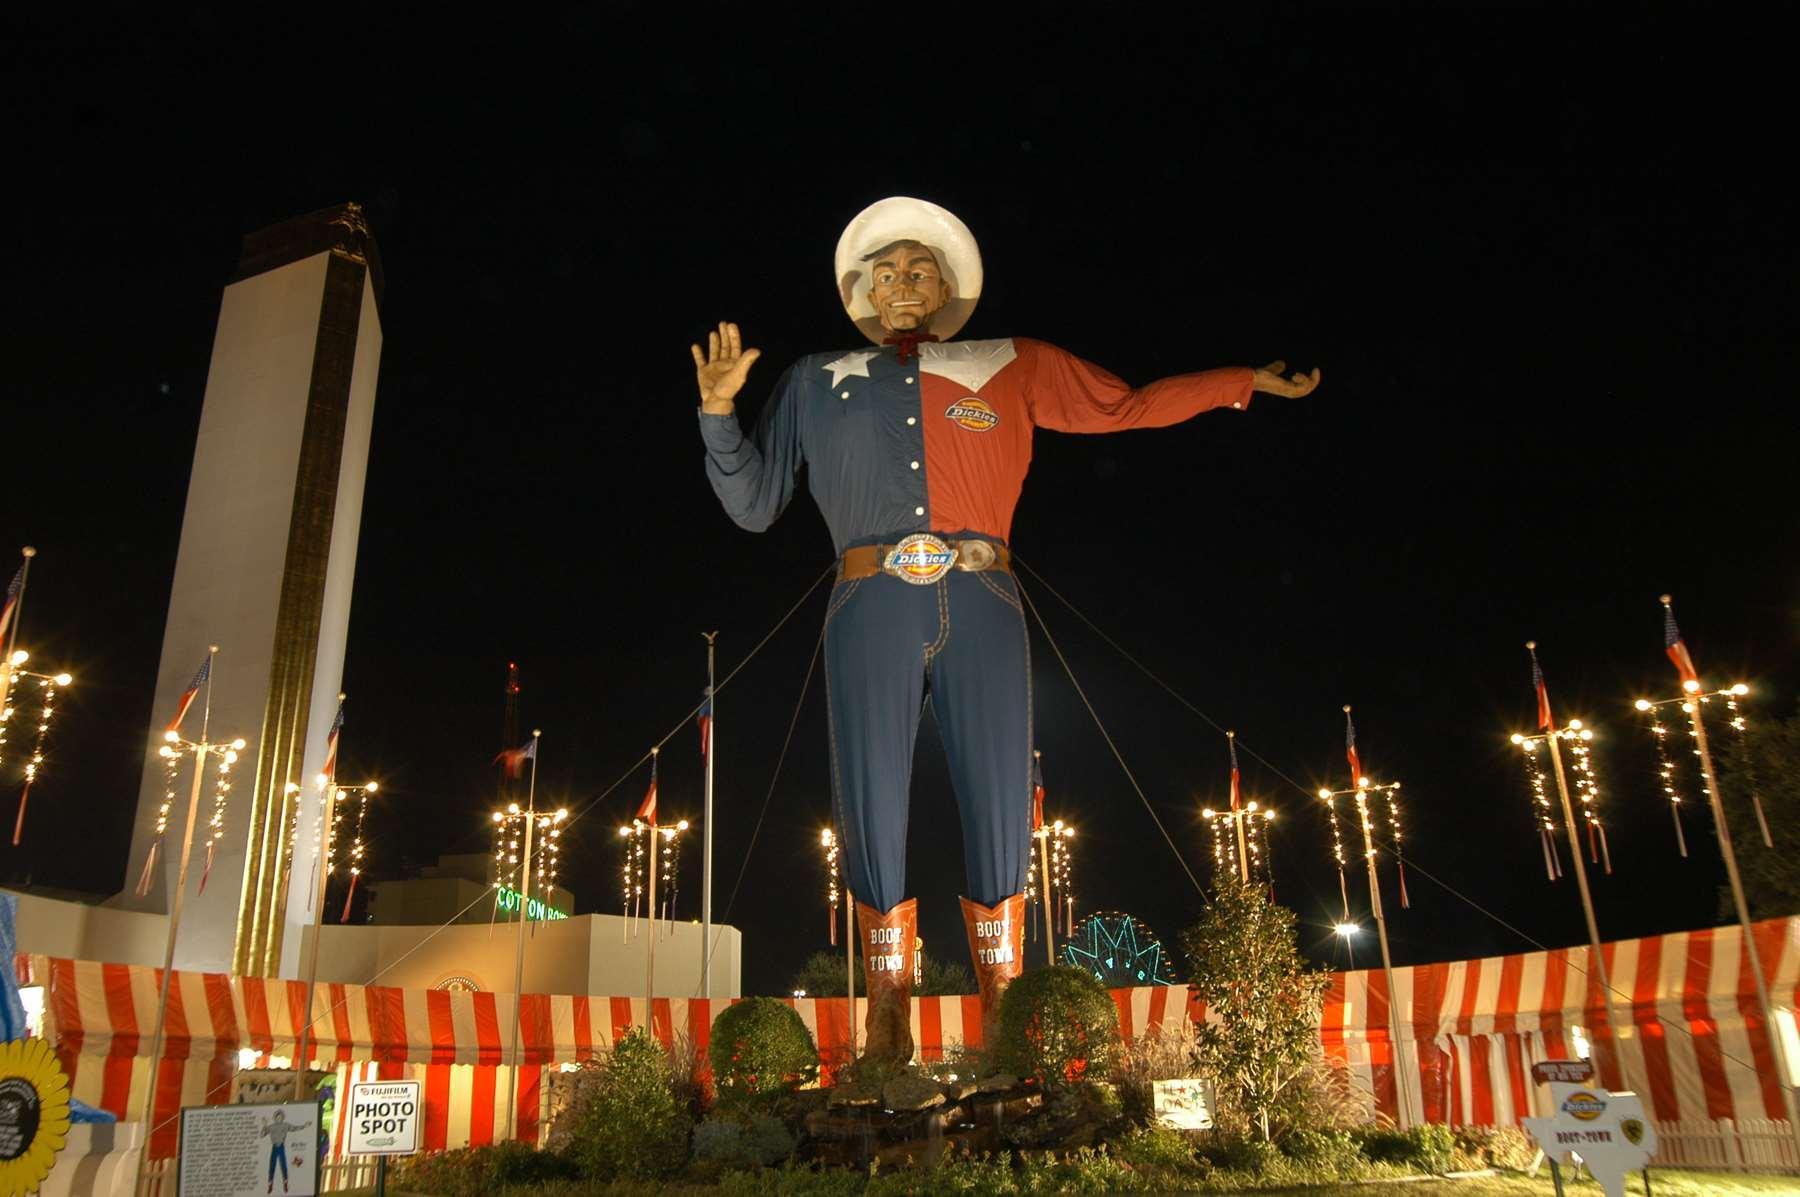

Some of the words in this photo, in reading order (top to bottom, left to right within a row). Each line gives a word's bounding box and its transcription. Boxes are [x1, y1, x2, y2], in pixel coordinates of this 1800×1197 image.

[953, 407, 996, 423] Dickies
[498, 886, 545, 921] COTON
[870, 927, 904, 944] BOOT
[976, 919, 1012, 938] BOOT
[870, 955, 904, 972] TOWN
[978, 945, 1014, 965] TOWN
[371, 1087, 408, 1095] FUJIFILM
[354, 1101, 414, 1118] PHOTO
[360, 1118, 407, 1135] SPOT
